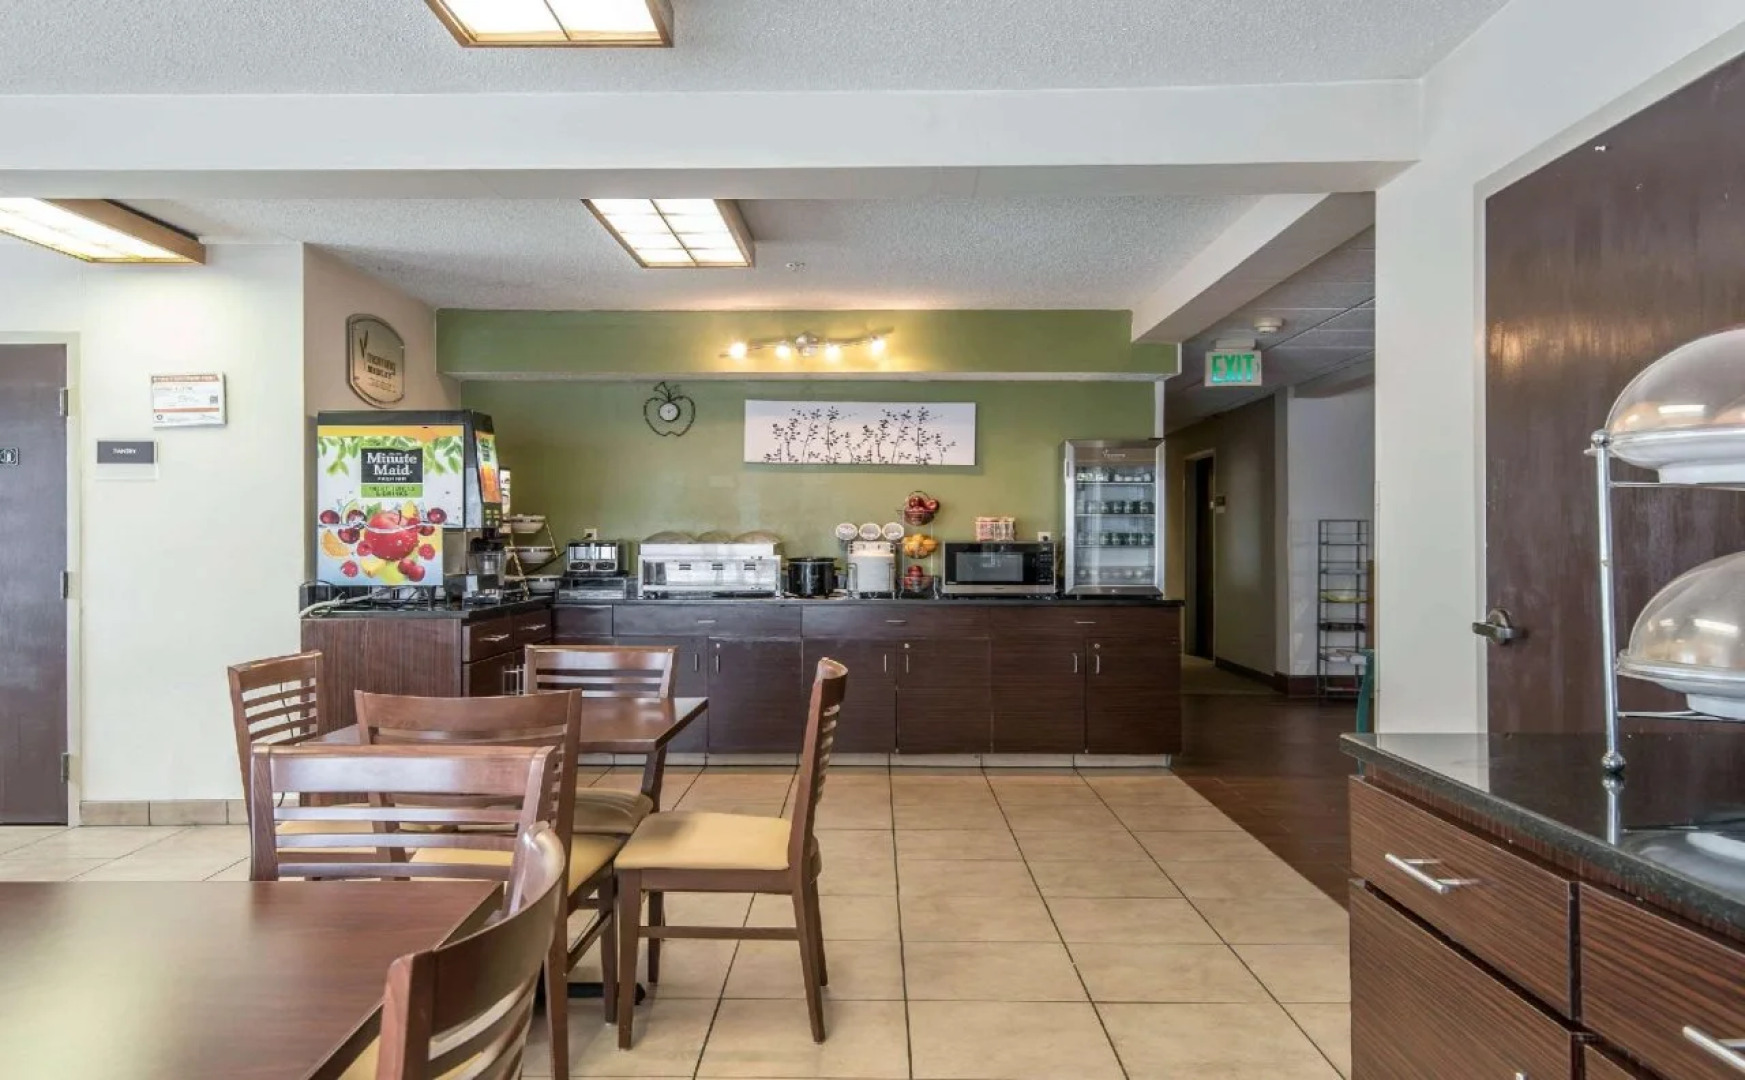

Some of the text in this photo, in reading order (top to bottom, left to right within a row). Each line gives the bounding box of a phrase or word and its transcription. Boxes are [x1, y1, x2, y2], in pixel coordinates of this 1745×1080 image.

[1211, 354, 1255, 383] EXIT
[367, 452, 417, 464] Minute
[373, 464, 410, 475] Maid
